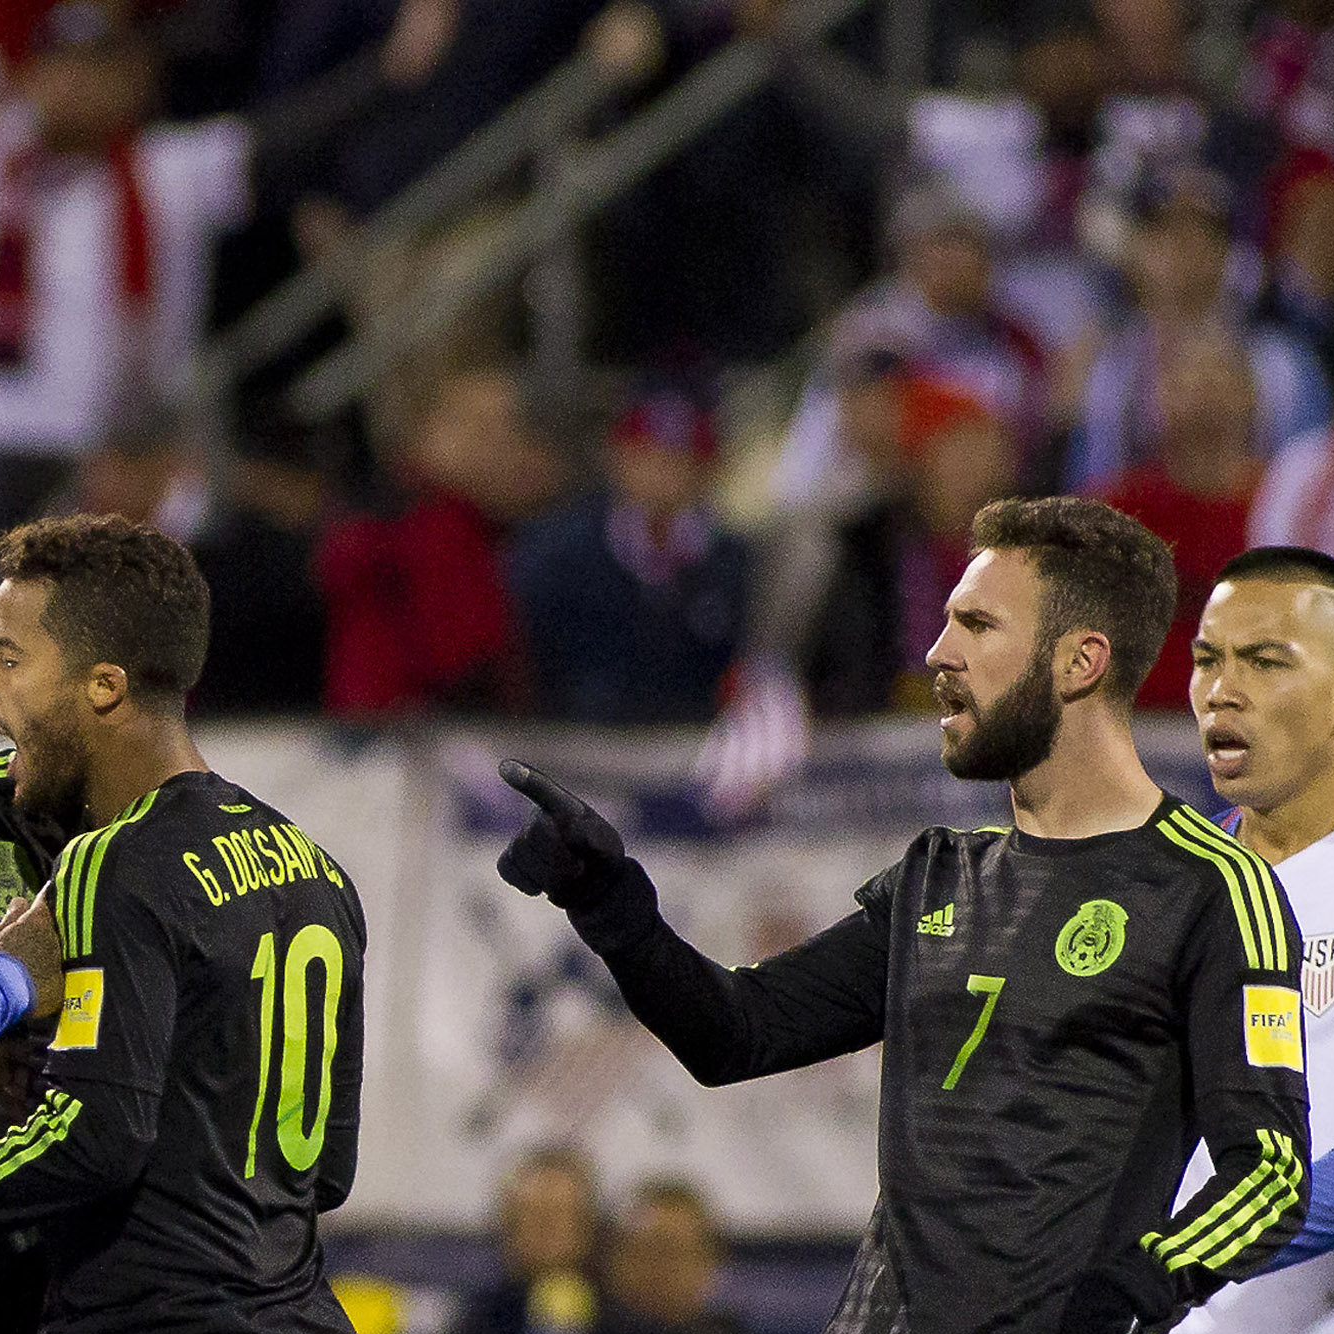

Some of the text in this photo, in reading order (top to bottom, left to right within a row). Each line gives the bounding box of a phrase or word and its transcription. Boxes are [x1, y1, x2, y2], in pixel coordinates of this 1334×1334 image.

[244, 924, 343, 1180] 10
[941, 973, 1007, 1091] 7
[1250, 1013, 1286, 1027] FIFA
